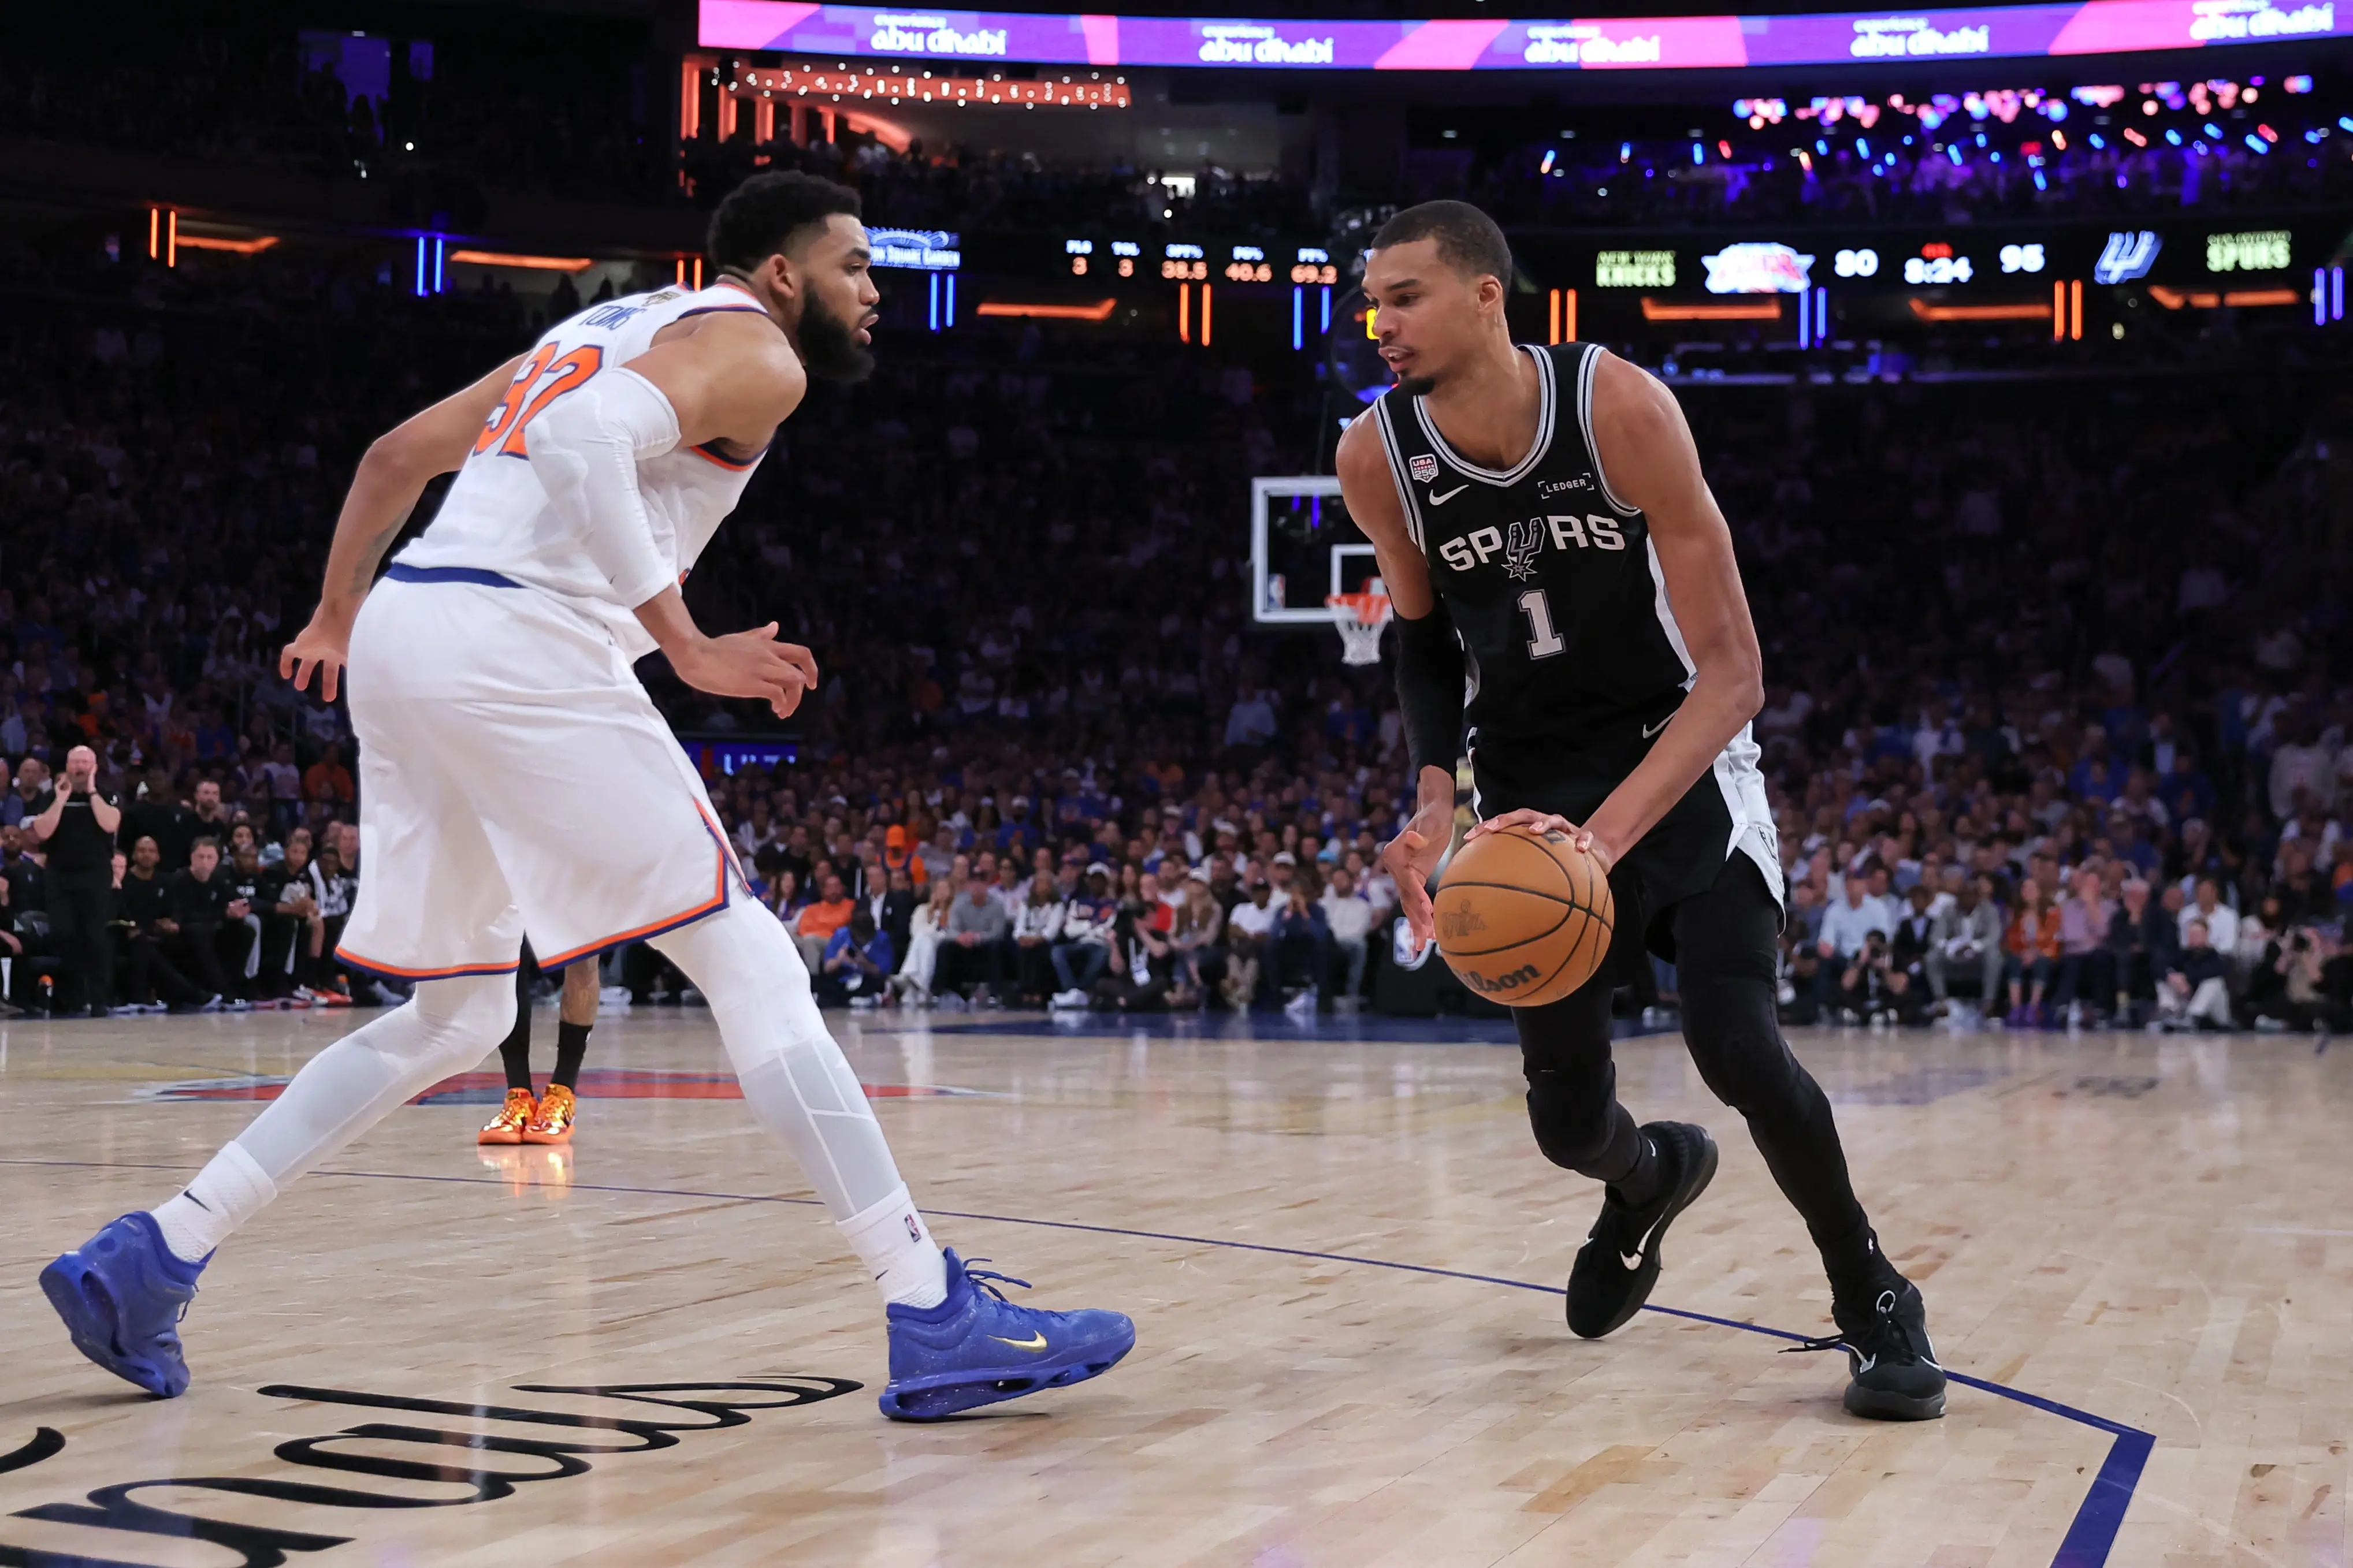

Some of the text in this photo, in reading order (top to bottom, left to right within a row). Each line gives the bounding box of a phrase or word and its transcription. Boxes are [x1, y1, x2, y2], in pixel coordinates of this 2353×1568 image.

[871, 27, 1007, 55] abu dhabi
[1199, 37, 1334, 64] abu dhabi
[1834, 248, 1879, 277] 80
[1999, 243, 2046, 273] 95
[2207, 241, 2291, 272] SPURS
[1596, 263, 1676, 287] KNICKS
[472, 340, 605, 461] 32
[1412, 458, 1433, 467] USA
[1415, 468, 1436, 478] 250
[1545, 478, 1587, 493] LEDGER
[1440, 513, 1626, 582] SPURS
[1518, 589, 1566, 660] 1
[1452, 964, 1541, 992] ilson
